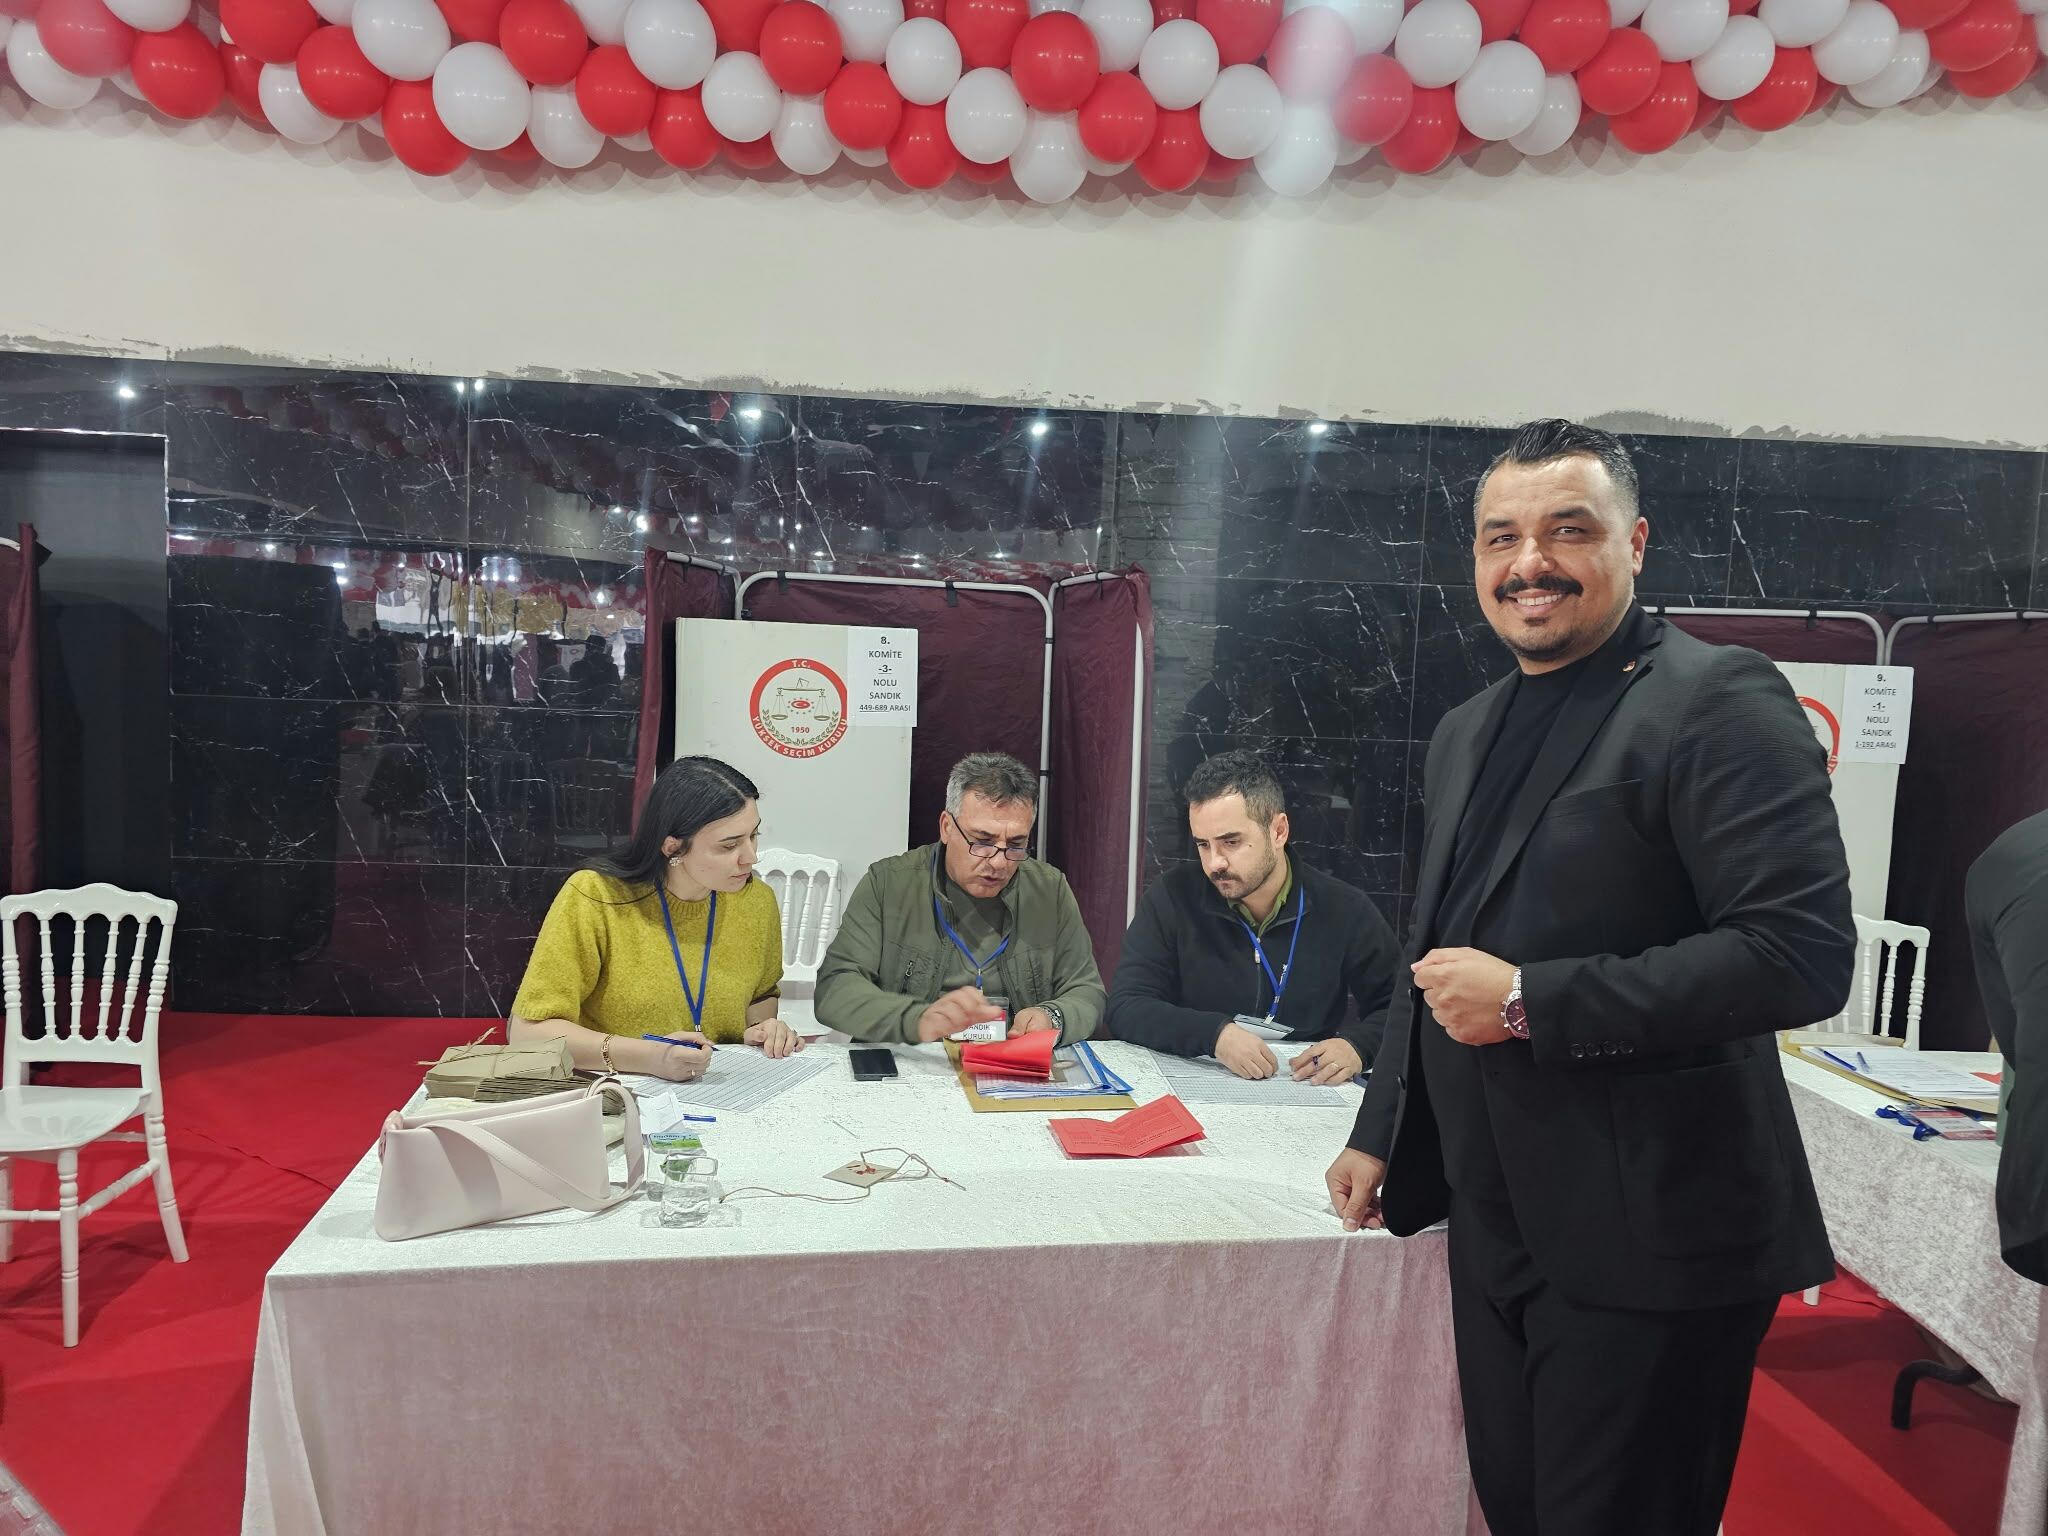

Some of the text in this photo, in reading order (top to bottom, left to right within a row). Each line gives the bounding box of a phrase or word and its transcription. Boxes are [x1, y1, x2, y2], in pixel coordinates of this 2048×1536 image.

[880, 636, 891, 645] 8.
[868, 649, 903, 659] KOMİTE
[791, 659, 811, 668] T.C.
[878, 664, 893, 674] -3-
[1876, 673, 1887, 682] 9.
[873, 679, 898, 687] NOLU
[869, 691, 902, 700] SANDIK
[1864, 686, 1897, 696] KOMİTE
[859, 704, 911, 713] 449-689 ARASI
[1872, 701, 1886, 711] -1-
[1865, 715, 1890, 724] NOLU
[791, 726, 811, 734] 1950
[1861, 728, 1893, 737] SANDIK
[752, 715, 848, 760] YÜKSEK SEÇİM KURULU
[1875, 741, 1897, 749] ARASI
